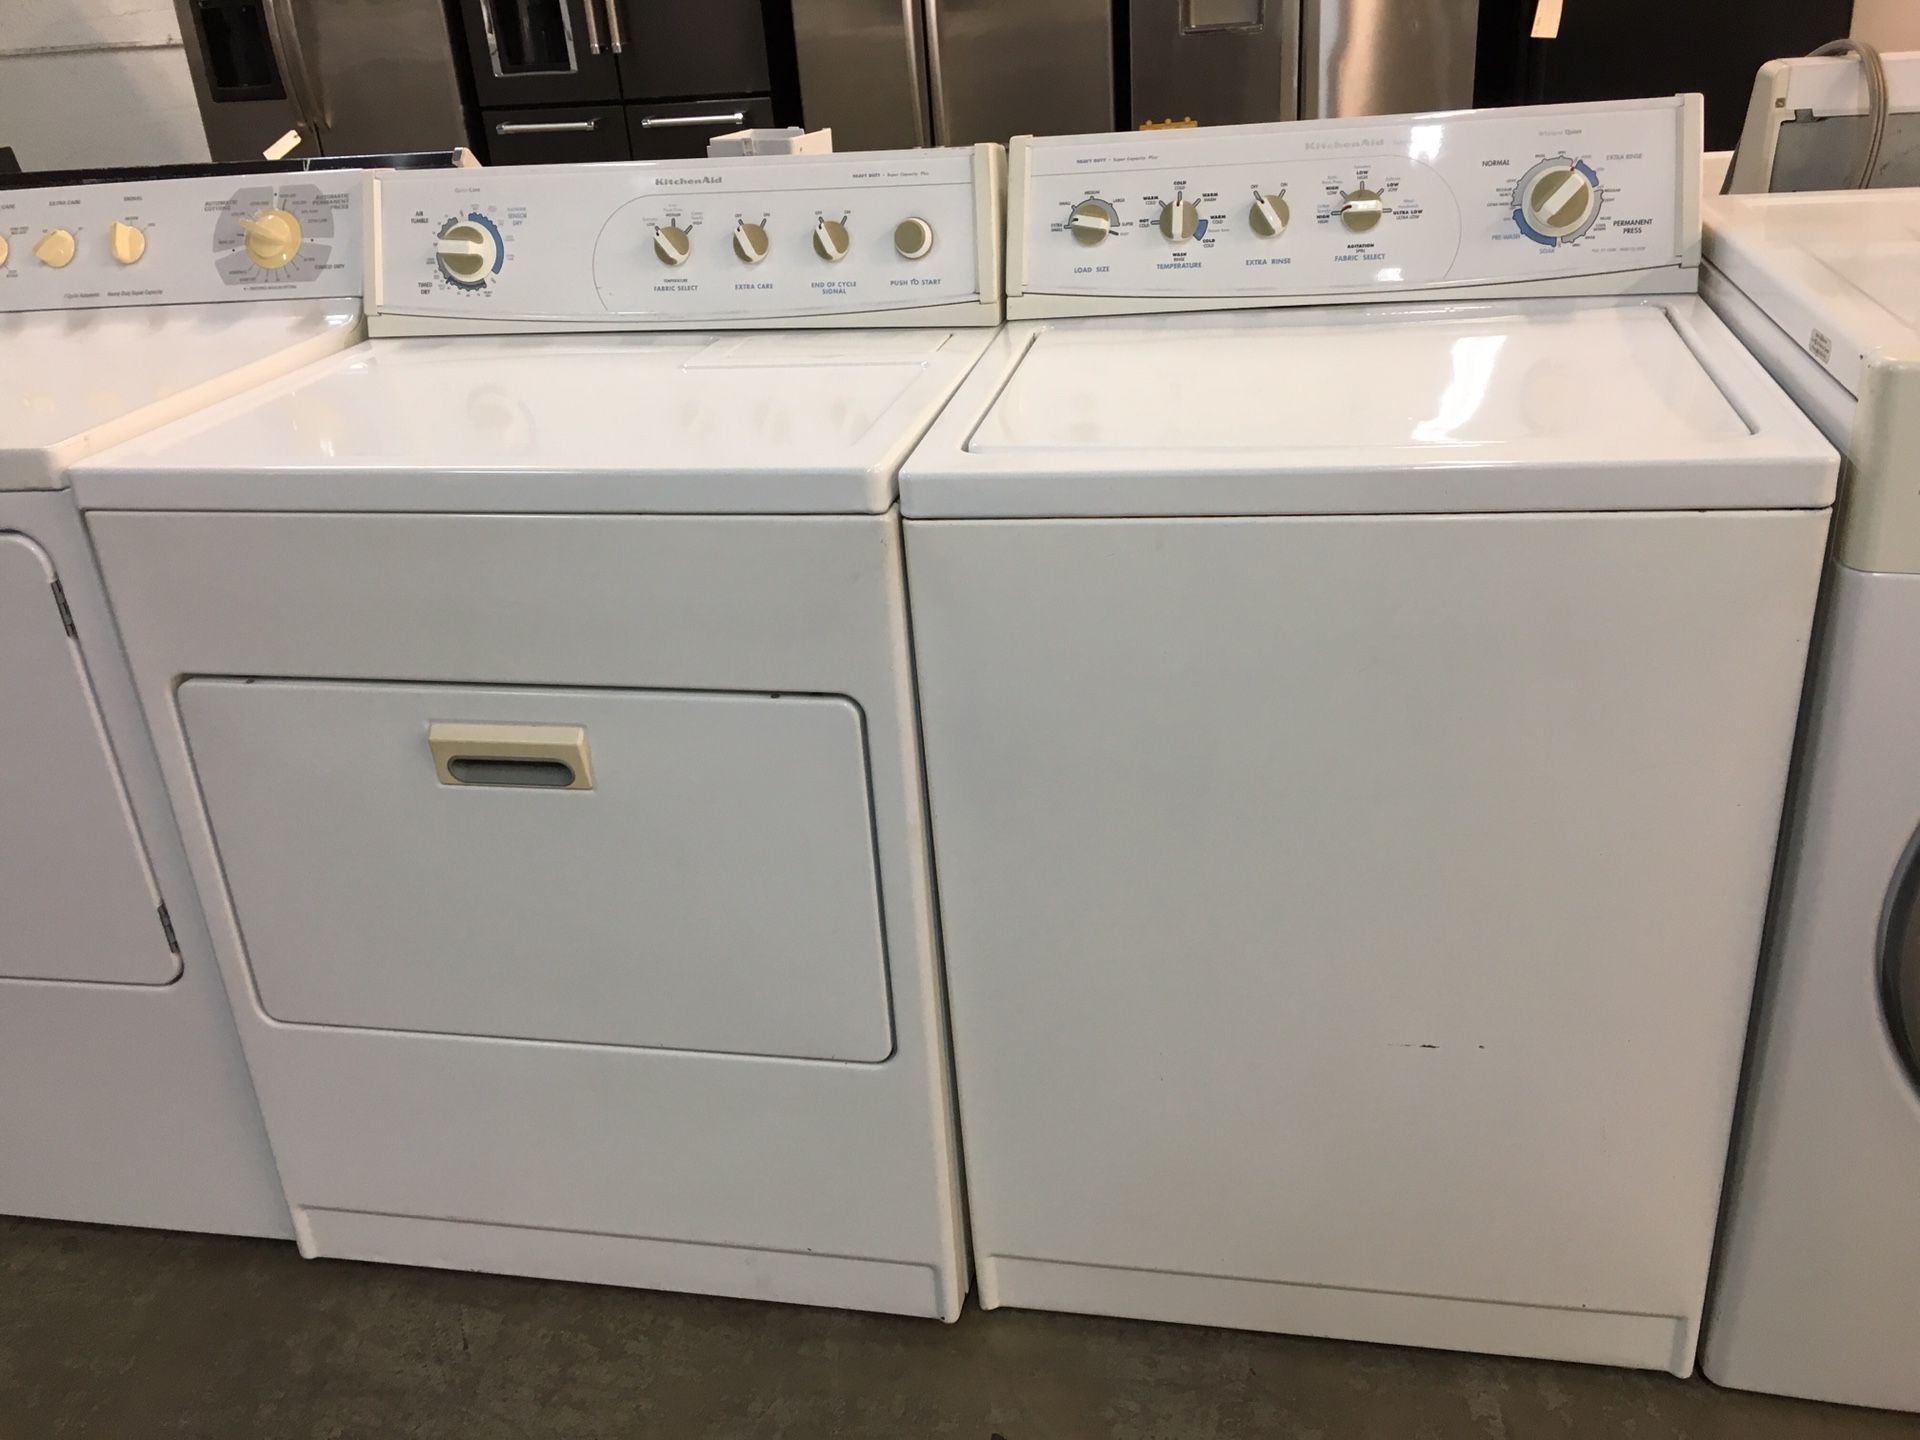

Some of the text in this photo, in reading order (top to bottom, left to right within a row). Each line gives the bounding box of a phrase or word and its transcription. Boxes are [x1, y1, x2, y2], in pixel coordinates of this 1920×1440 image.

[1304, 138, 1384, 150] KitchenAid
[655, 176, 722, 185] KitchenAid
[1362, 252, 1386, 261] SELECT
[1074, 265, 1092, 274] LOAD
[1157, 261, 1202, 270] TEMPERATURE
[821, 287, 846, 295] SIGNAL
